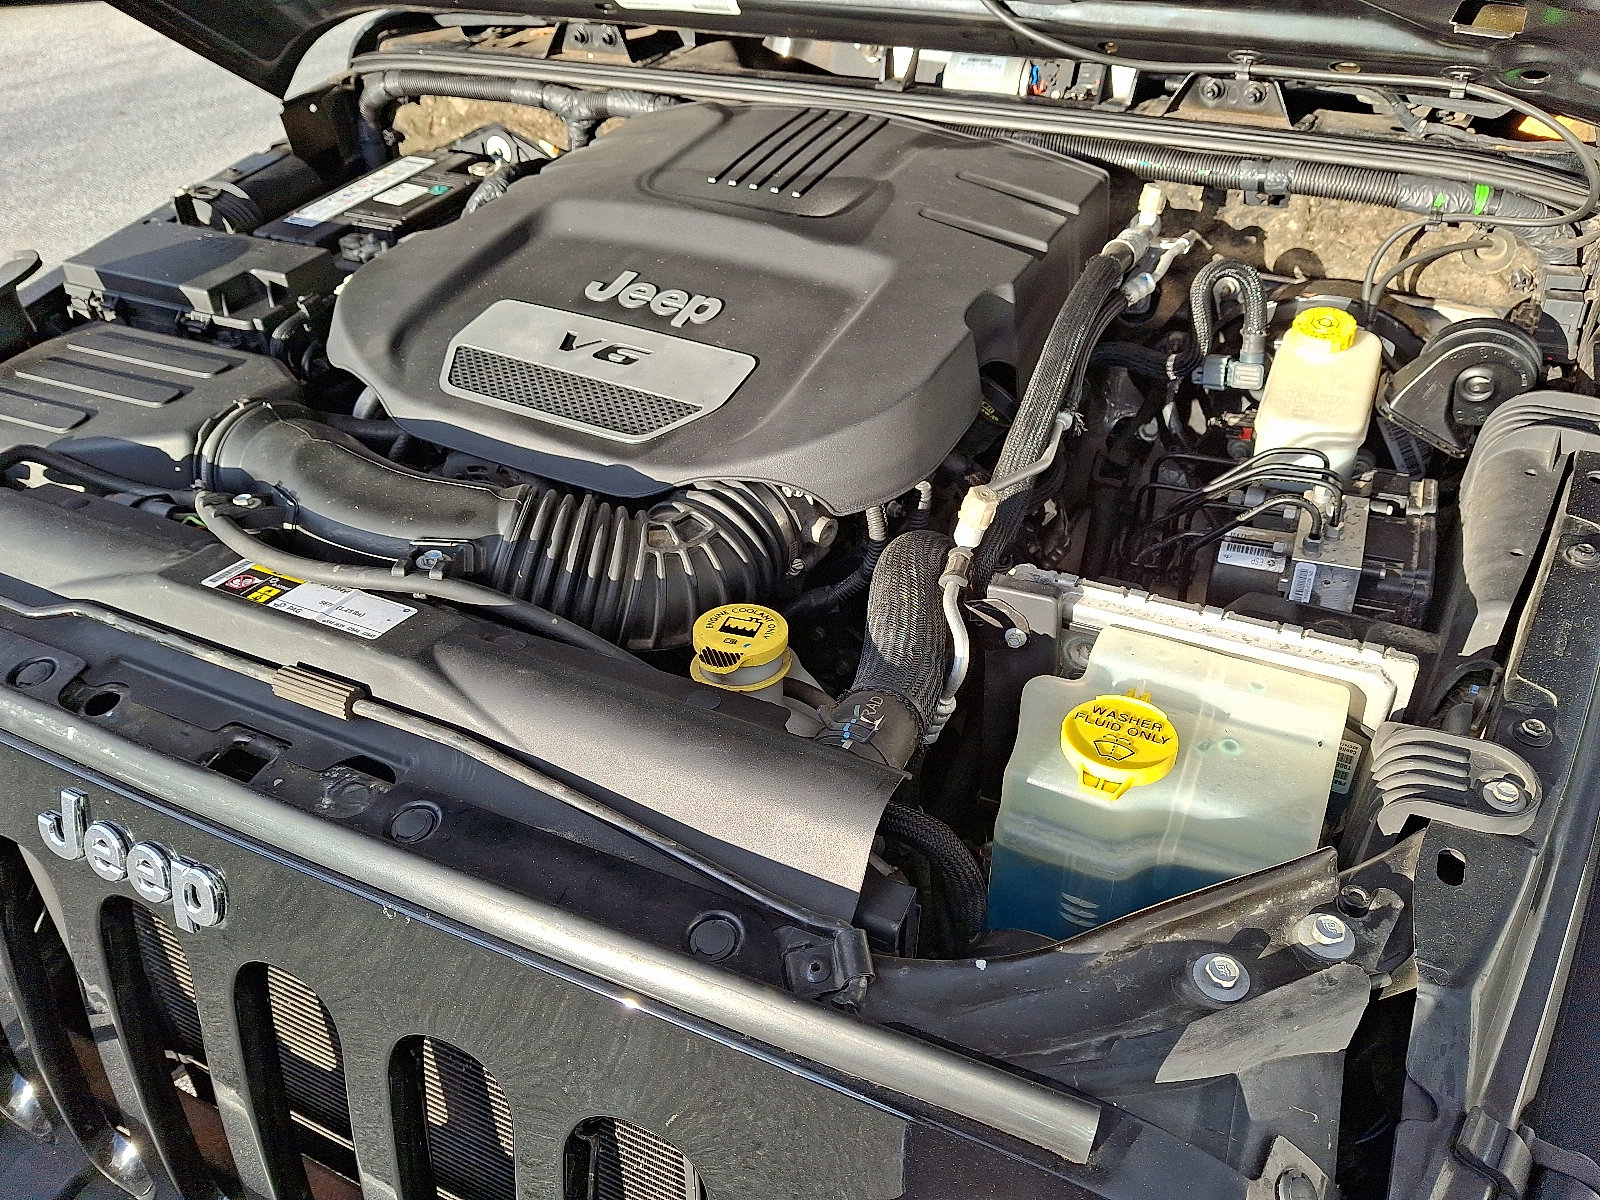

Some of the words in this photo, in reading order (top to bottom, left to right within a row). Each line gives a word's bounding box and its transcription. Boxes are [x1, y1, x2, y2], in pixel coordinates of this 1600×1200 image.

[585, 270, 723, 328] Jeep
[558, 330, 655, 366] V6
[706, 609, 730, 629] ENGINE
[731, 607, 775, 625] COOLANT
[763, 624, 776, 640] ONLY
[1074, 711, 1122, 732] FLUID
[1127, 727, 1171, 745] ONLY
[1093, 705, 1163, 733] WASHER
[37, 786, 229, 934] Jeep
